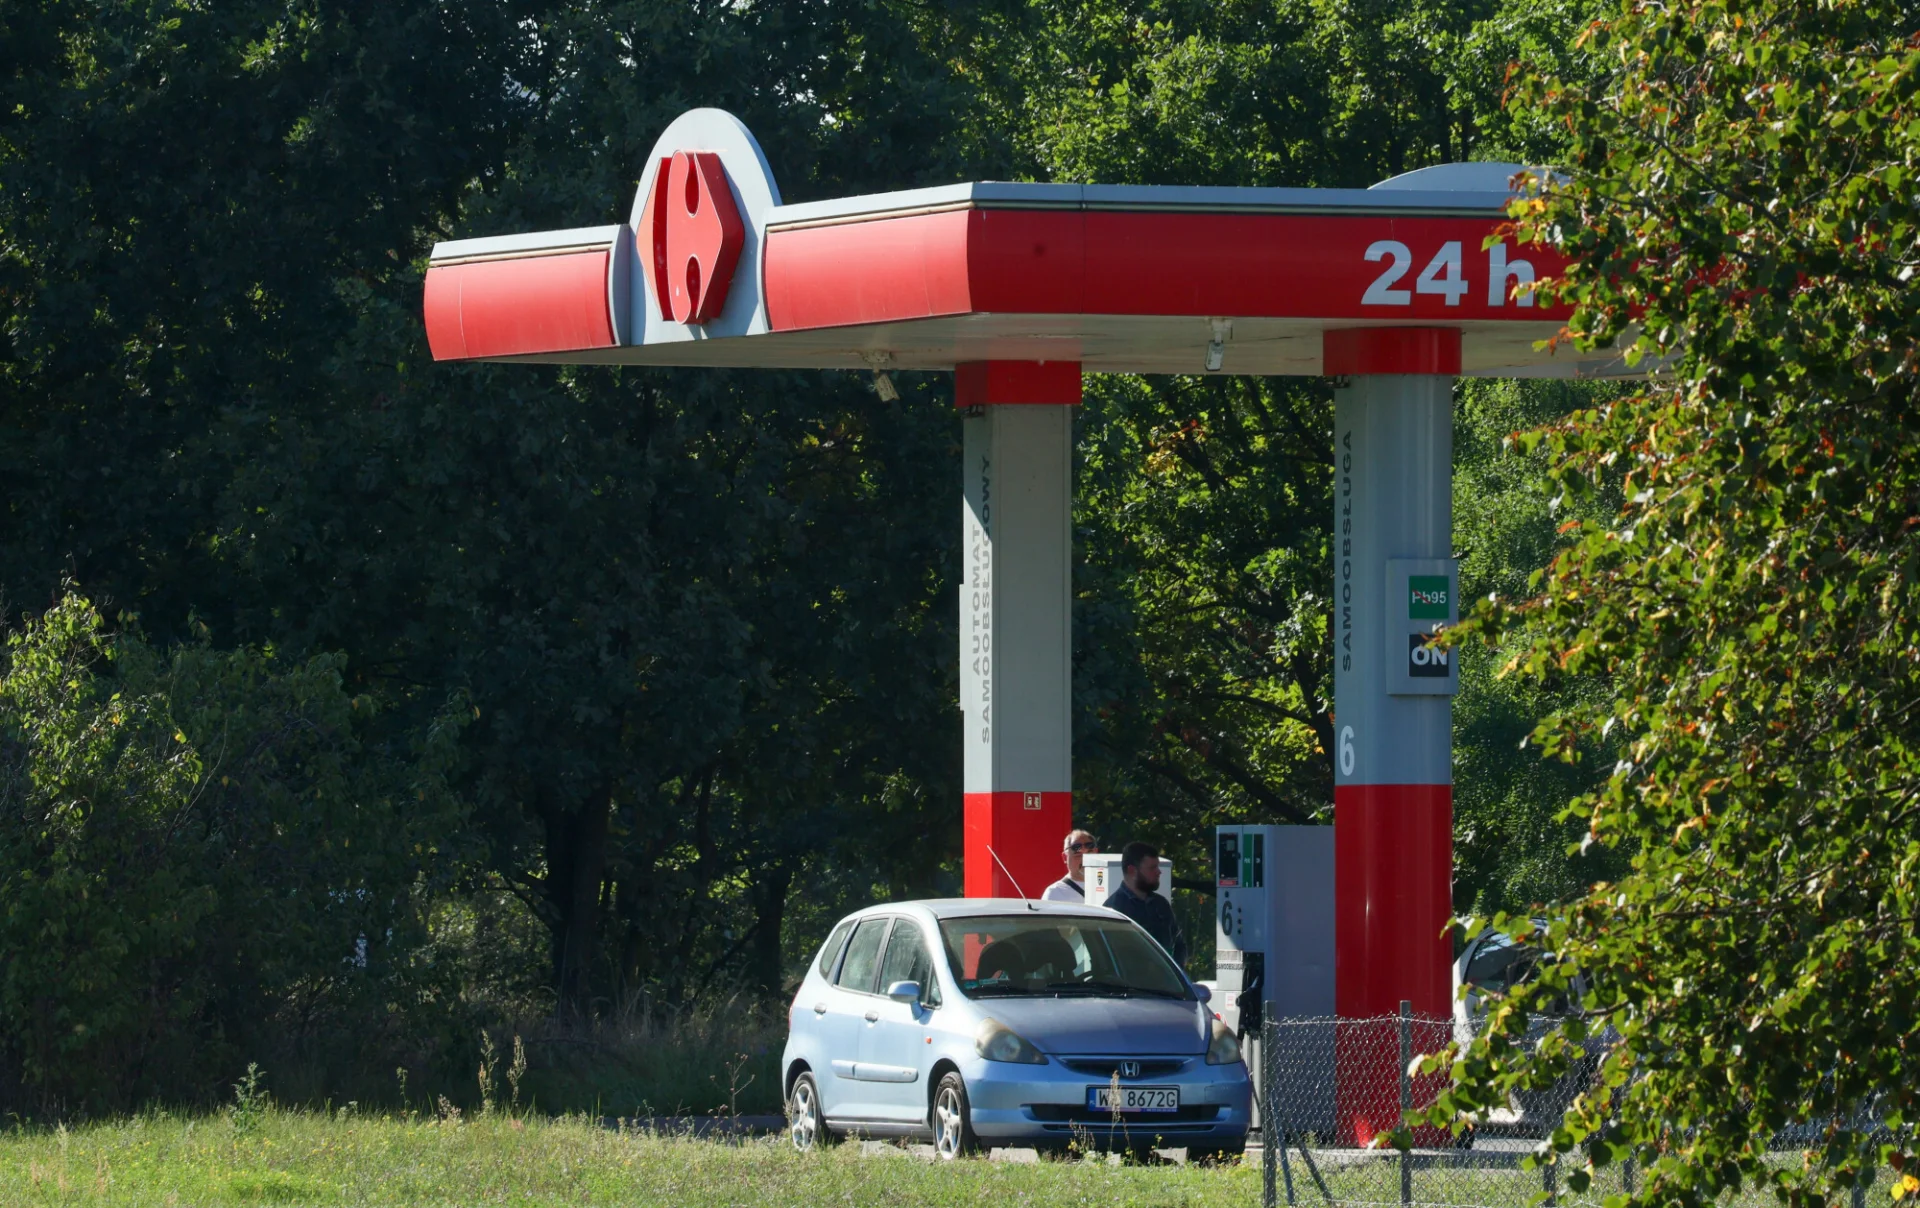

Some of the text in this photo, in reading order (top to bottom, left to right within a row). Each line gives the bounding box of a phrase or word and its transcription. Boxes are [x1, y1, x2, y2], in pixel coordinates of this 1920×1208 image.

[1361, 240, 1535, 307] 24 h
[1342, 429, 1352, 672] SAMOOBSŁUGA
[972, 524, 980, 676] AUTOMAT
[982, 455, 990, 744] SAMOOBSŁUGOWY
[1412, 591, 1447, 604] Pb95
[1411, 645, 1448, 666] ON
[1339, 725, 1355, 776] 6
[1221, 900, 1233, 936] 6
[1127, 1091, 1176, 1107] 8672G
